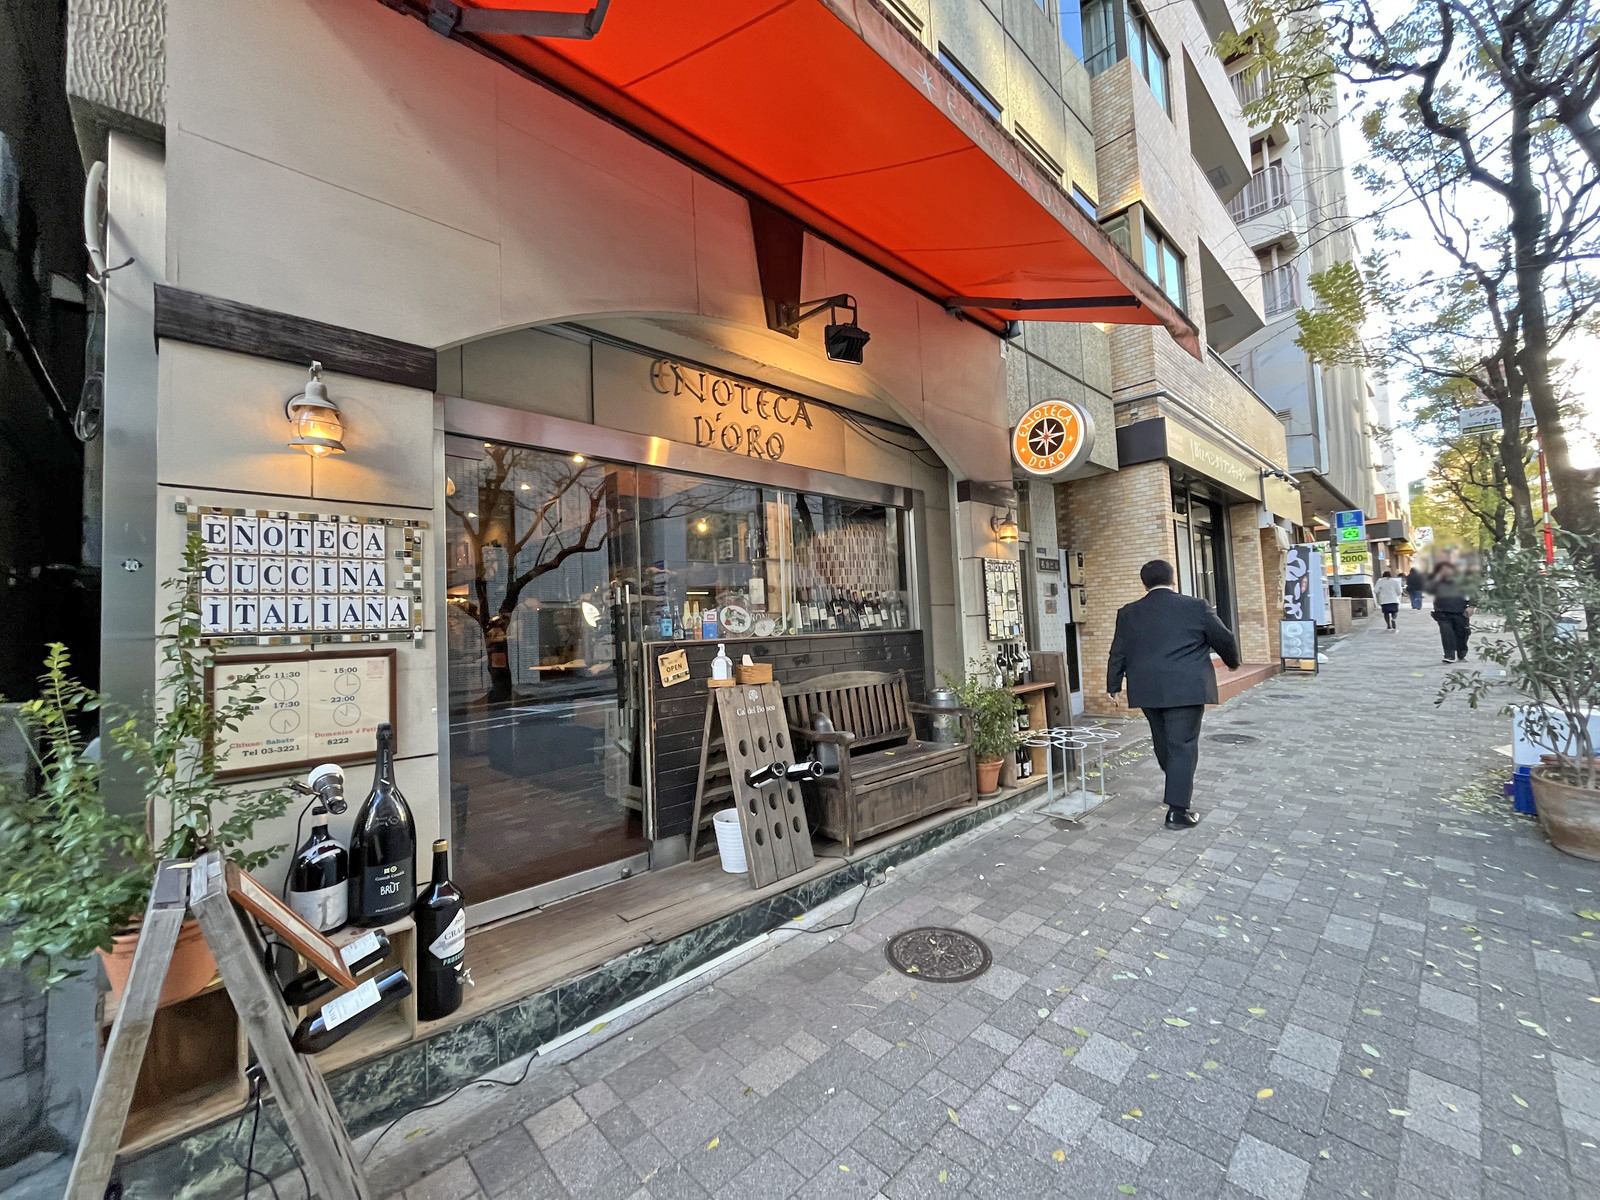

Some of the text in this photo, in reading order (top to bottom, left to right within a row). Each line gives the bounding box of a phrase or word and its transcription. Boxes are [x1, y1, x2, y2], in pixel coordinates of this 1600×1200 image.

[651, 358, 813, 430] ENOTECA
[1018, 405, 1073, 437] ENOTECA
[693, 412, 785, 461] D'ORO
[205, 523, 383, 551] ENOTECA
[205, 563, 384, 588] CUCCINA
[987, 563, 1014, 573] ENOTECA
[209, 602, 408, 626] ITALIANA
[274, 671, 301, 679] 11:30
[334, 666, 358, 674] 15:00
[666, 663, 683, 673] OPEN
[273, 695, 356, 709] 17:30 22:00
[242, 737, 350, 757] Tel 03-3221 8222
[266, 736, 295, 746] Sabato
